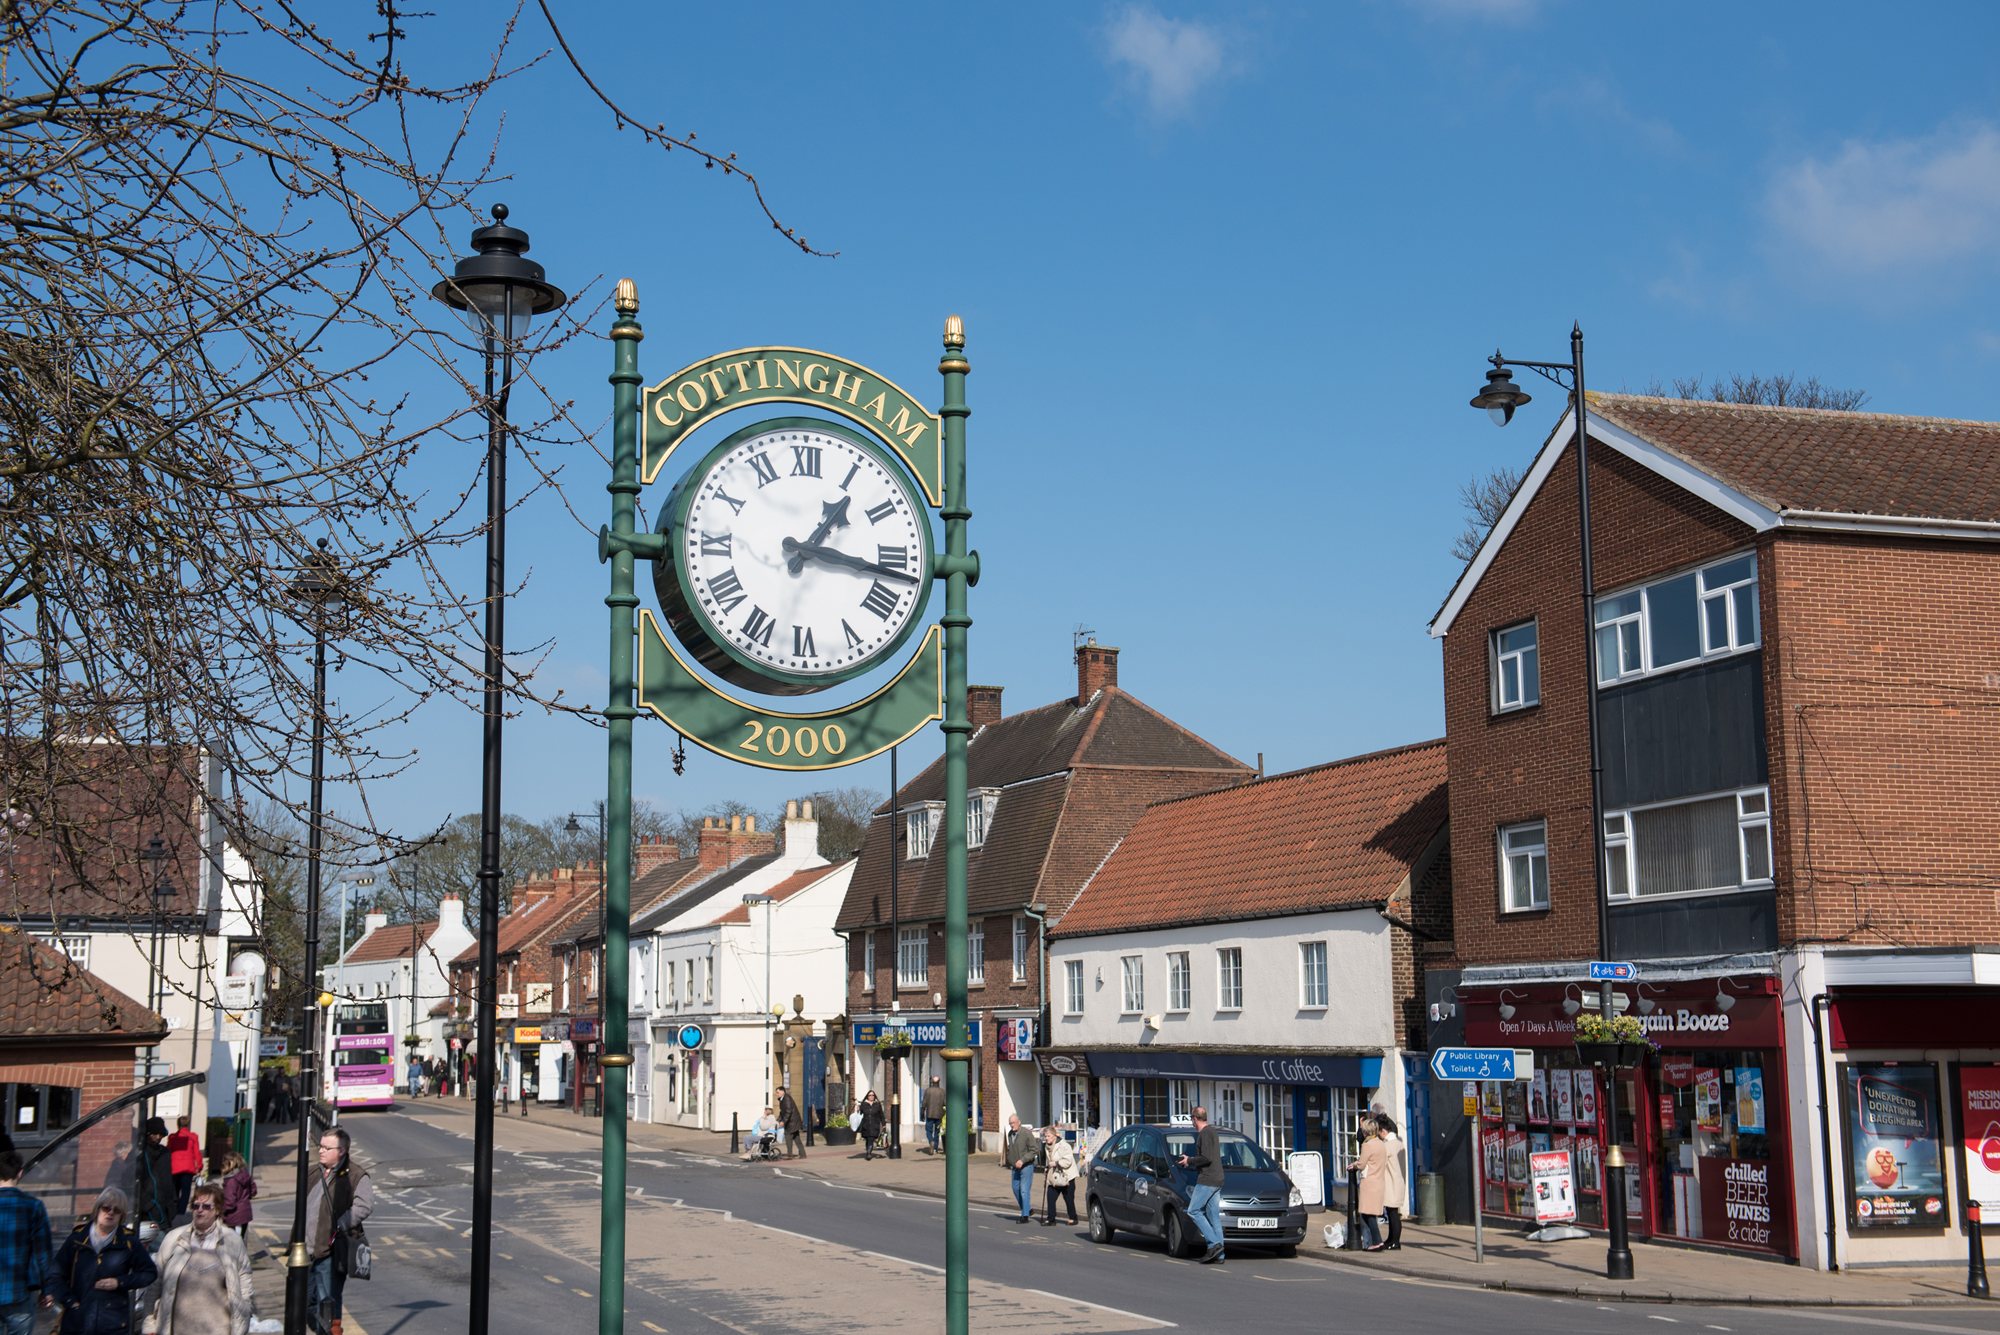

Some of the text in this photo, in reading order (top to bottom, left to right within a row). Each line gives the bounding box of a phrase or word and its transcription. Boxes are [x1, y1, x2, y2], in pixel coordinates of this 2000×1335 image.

[654, 358, 928, 448] COTTINGHAM
[745, 451, 780, 489] XI
[790, 446, 823, 479] XII
[839, 462, 862, 492] I
[713, 485, 746, 516] X
[865, 498, 898, 526] II
[701, 531, 732, 559] IX
[706, 566, 748, 616] VIII
[860, 578, 901, 622] IIII
[740, 604, 777, 649] VII
[841, 618, 864, 650] V
[793, 626, 818, 657] VI
[740, 720, 848, 759] 2000
[1499, 1020, 1576, 1035] Open 7 Days A Week
[1676, 1009, 1730, 1031] Booze
[520, 1029, 541, 1037] Koda
[882, 1026, 946, 1041] FULONS FOODS
[1449, 1052, 1500, 1061] Public Library
[1262, 1059, 1324, 1081] CC Coffee
[1451, 1064, 1475, 1073] Toilets
[1696, 1069, 1714, 1082] WOW
[1968, 1090, 2000, 1100] MISSIN
[1969, 1100, 2000, 1110] MILLIO
[1868, 1101, 1917, 1117] DONATION IN
[1869, 1113, 1906, 1126] BAGGING
[1724, 1162, 1767, 1183] chilled
[1725, 1180, 1769, 1205] BEER
[1241, 1219, 1276, 1227] NV07 JDU
[1726, 1202, 1771, 1222] WINES
[1728, 1221, 1771, 1244] & cider
